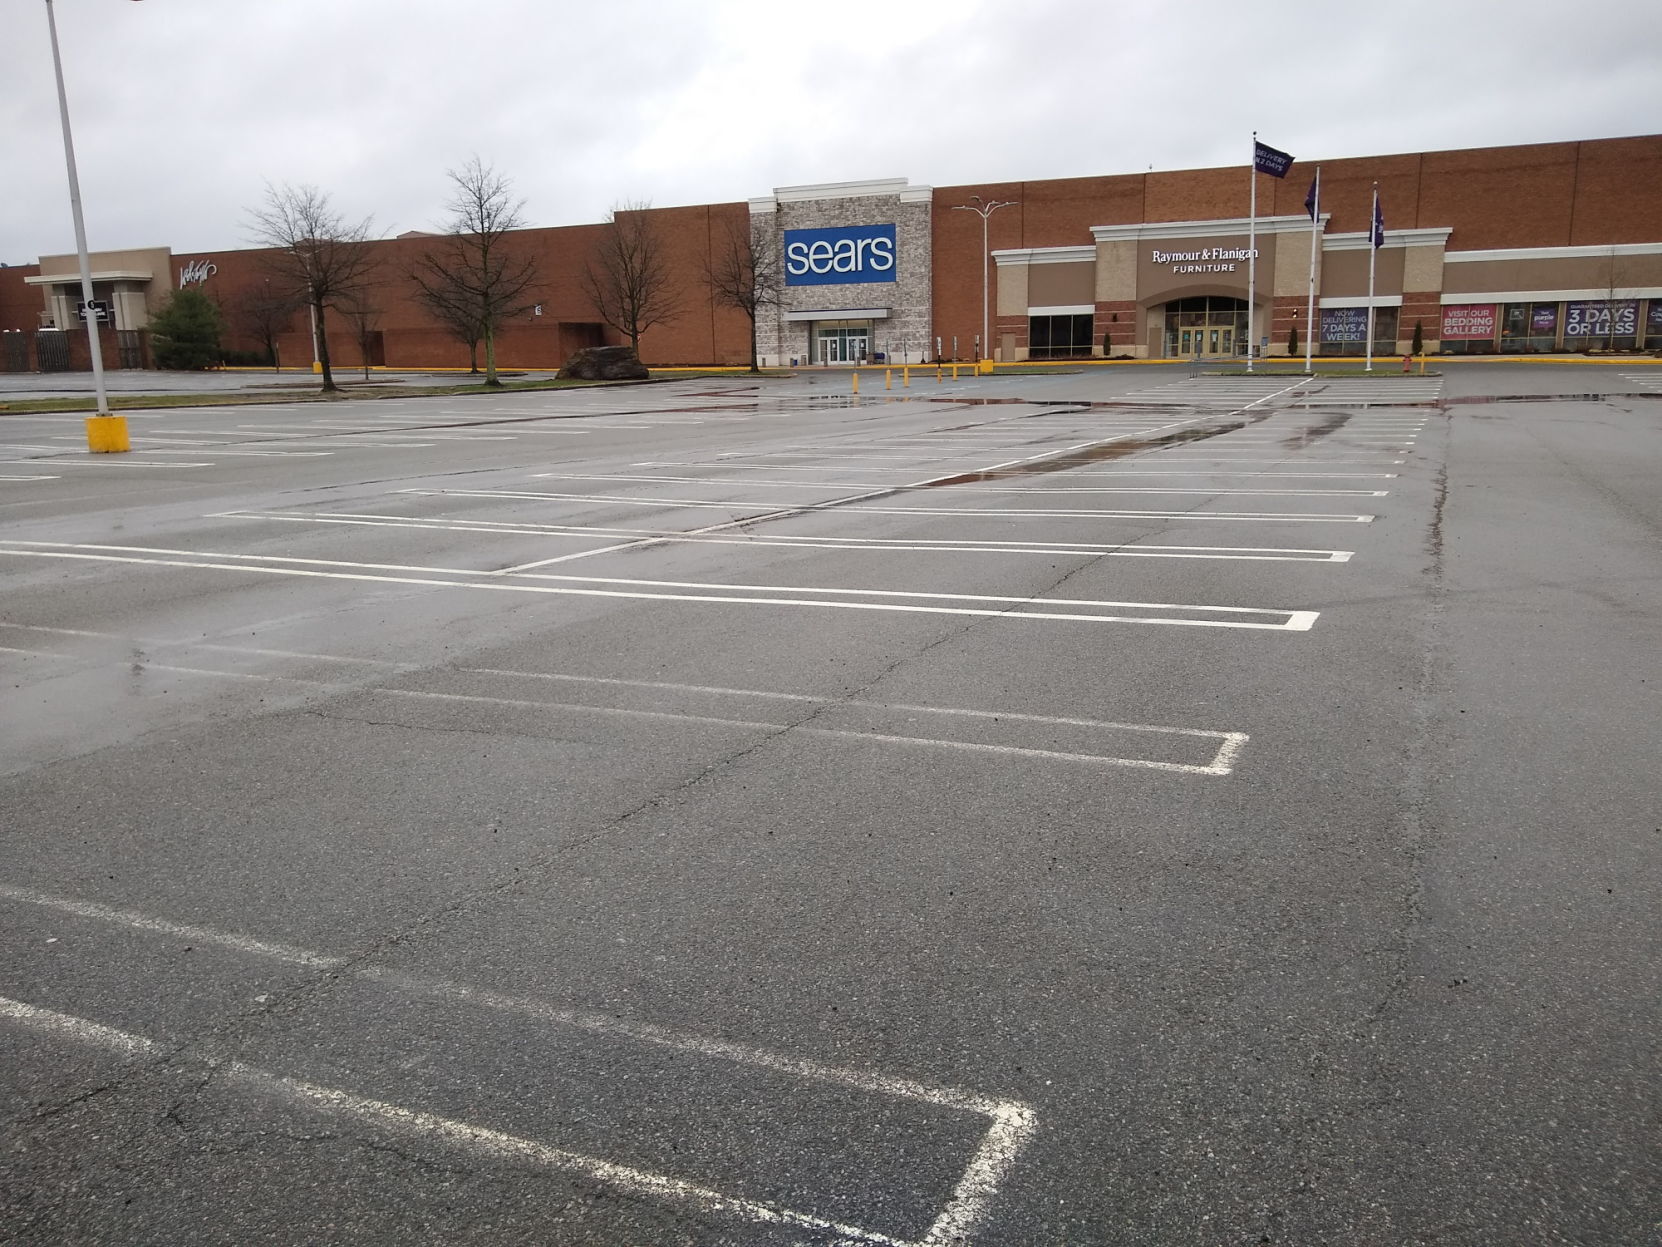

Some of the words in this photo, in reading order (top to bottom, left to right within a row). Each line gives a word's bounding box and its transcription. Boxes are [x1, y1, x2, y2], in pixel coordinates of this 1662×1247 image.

[1266, 160, 1284, 172] DAYS
[787, 237, 893, 275] sears
[1152, 250, 1200, 264] Raymour
[1201, 248, 1211, 260] &
[1212, 247, 1258, 262] Flanigan
[1173, 263, 1235, 274] FURNITURE
[1470, 309, 1489, 317] OUR
[1568, 309, 1581, 323] 3
[1586, 308, 1635, 323] DAYS
[1444, 317, 1493, 326] BEDDING
[1322, 324, 1329, 332] 7
[1330, 323, 1357, 332] DAYS
[1357, 323, 1367, 331] A
[1443, 326, 1493, 335] GALLERY
[1567, 323, 1592, 335] OR
[1595, 322, 1635, 334] LESS
[1326, 332, 1361, 341] WEEK!
